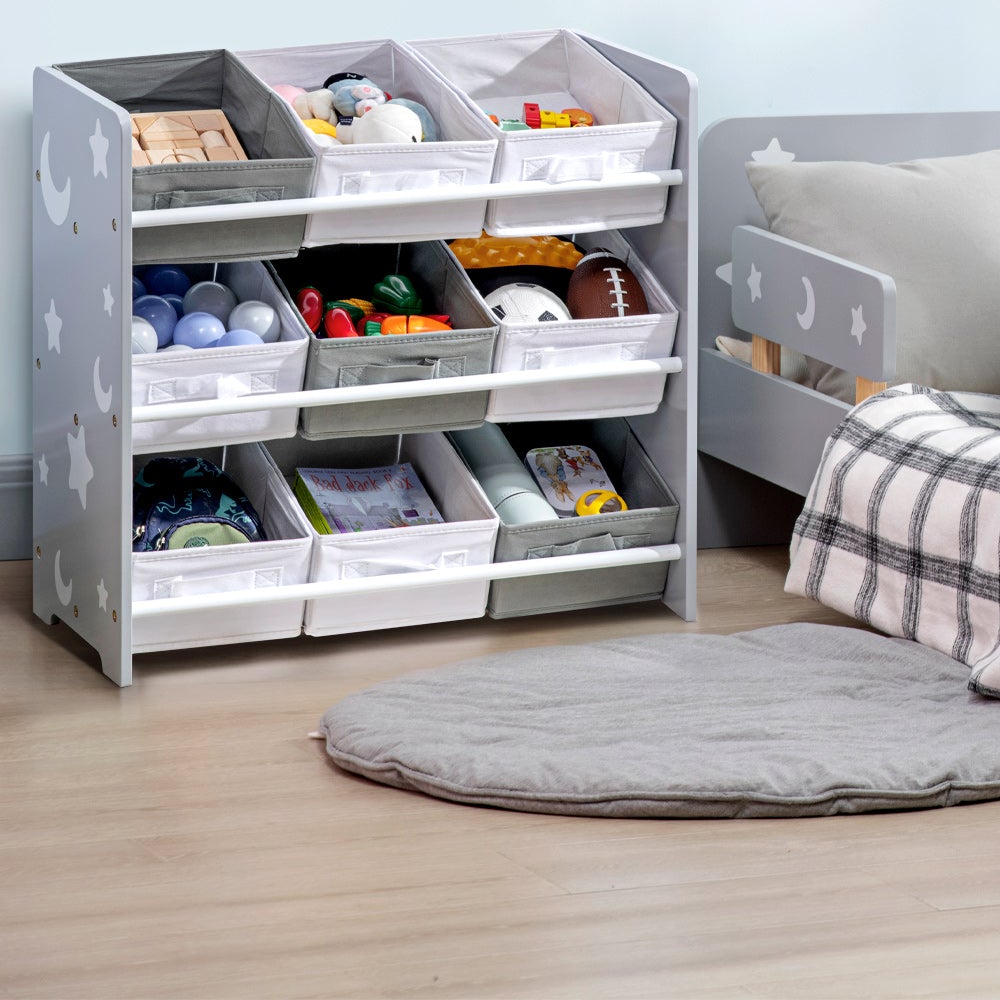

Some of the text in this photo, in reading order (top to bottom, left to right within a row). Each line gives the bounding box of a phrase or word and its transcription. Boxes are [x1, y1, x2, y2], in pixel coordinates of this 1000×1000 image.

[309, 473, 414, 492] Bad Jack Fox
